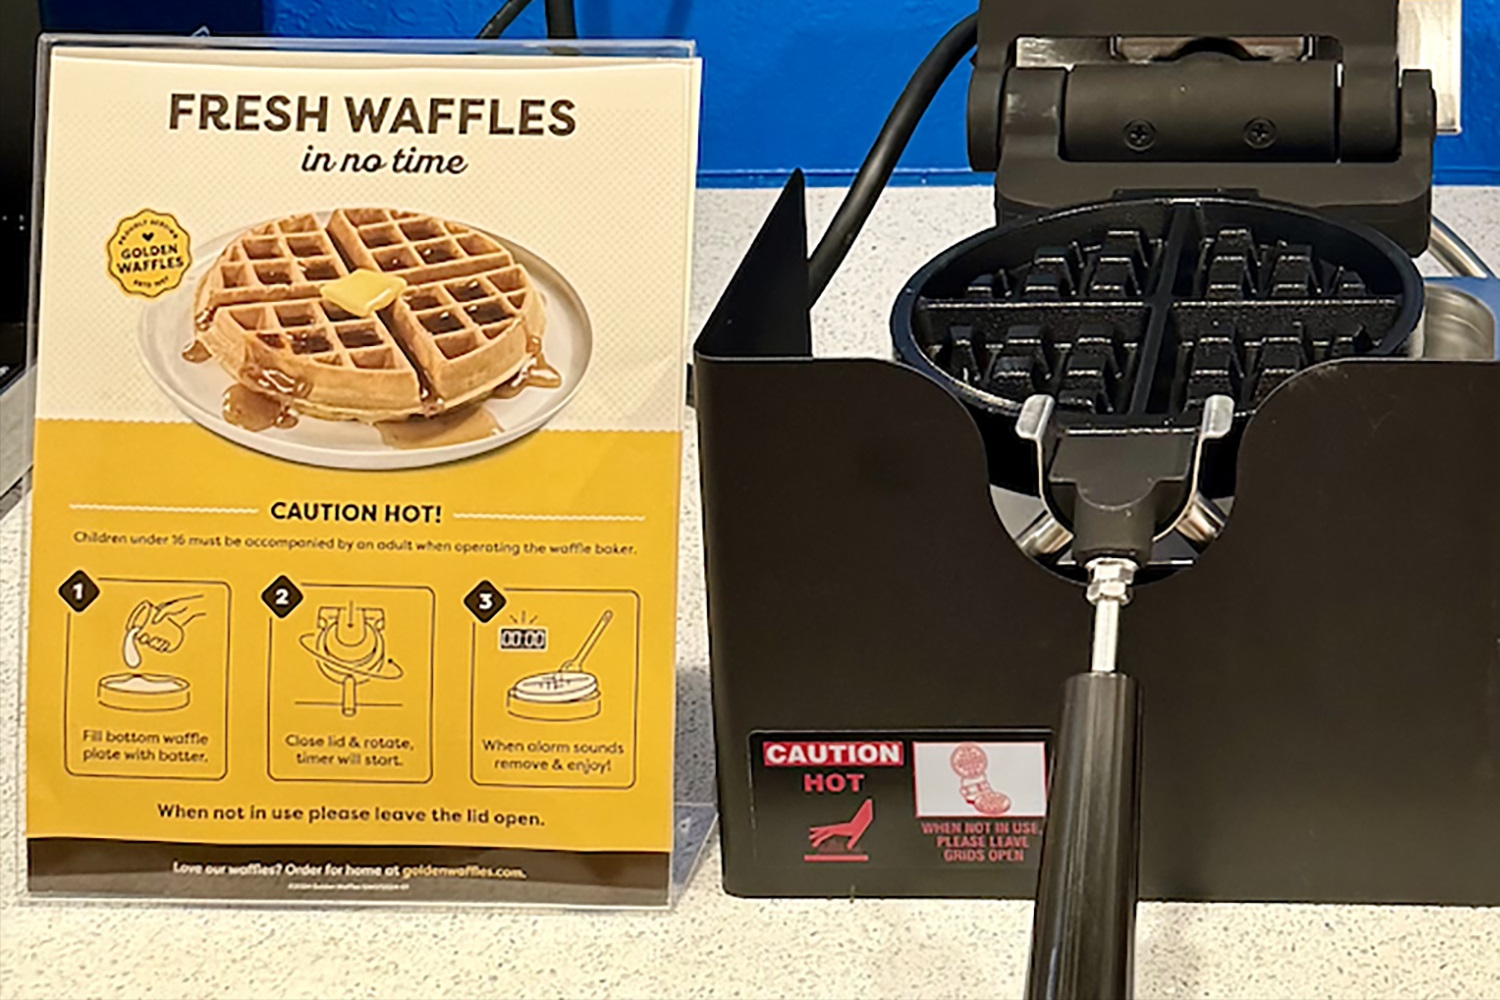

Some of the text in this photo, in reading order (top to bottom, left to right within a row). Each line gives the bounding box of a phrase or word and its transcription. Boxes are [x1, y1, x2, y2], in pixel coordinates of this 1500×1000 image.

[168, 93, 577, 137] FRESH WAFFLES
[301, 144, 468, 174] in no time
[121, 244, 178, 260] GOLDEN
[116, 256, 184, 274] WAFFLES
[271, 502, 442, 523] CAUTION HOT!
[73, 531, 127, 543] Children
[130, 533, 168, 545] under
[188, 535, 221, 546] must
[224, 535, 241, 547] be
[244, 537, 335, 551] accompanied
[337, 538, 353, 552] by
[356, 541, 374, 550] an
[377, 540, 413, 551] adult
[416, 540, 451, 552] when
[454, 541, 520, 556] operating
[523, 543, 546, 554] the
[549, 542, 591, 555] waffle
[594, 543, 637, 556] baker.
[72, 583, 83, 600] 1
[275, 588, 289, 604] 2
[479, 593, 493, 609] 3
[83, 729, 208, 745] Fill bottom waffle
[285, 734, 414, 751] Close lid & rotate,
[482, 739, 624, 754] When alarm sounds
[766, 744, 900, 764] CAUTION
[83, 747, 208, 763] plate with batter.
[297, 752, 403, 766] timer will start.
[494, 759, 611, 774] remove & enjoy!
[804, 773, 864, 793] HOT
[157, 804, 545, 828] When not in use please leave the lid open.
[921, 822, 961, 834] WHEN
[964, 822, 990, 834] NOT
[994, 822, 1009, 834] IN
[936, 836, 1029, 848] PLEASE LEAVE
[943, 849, 1024, 862] GRIDS OPEN
[173, 861, 202, 874] Love
[205, 864, 226, 875] our
[228, 862, 283, 876] waffles?
[285, 864, 322, 876] Order
[325, 863, 344, 876] for
[346, 864, 382, 877] home
[385, 865, 400, 877] at
